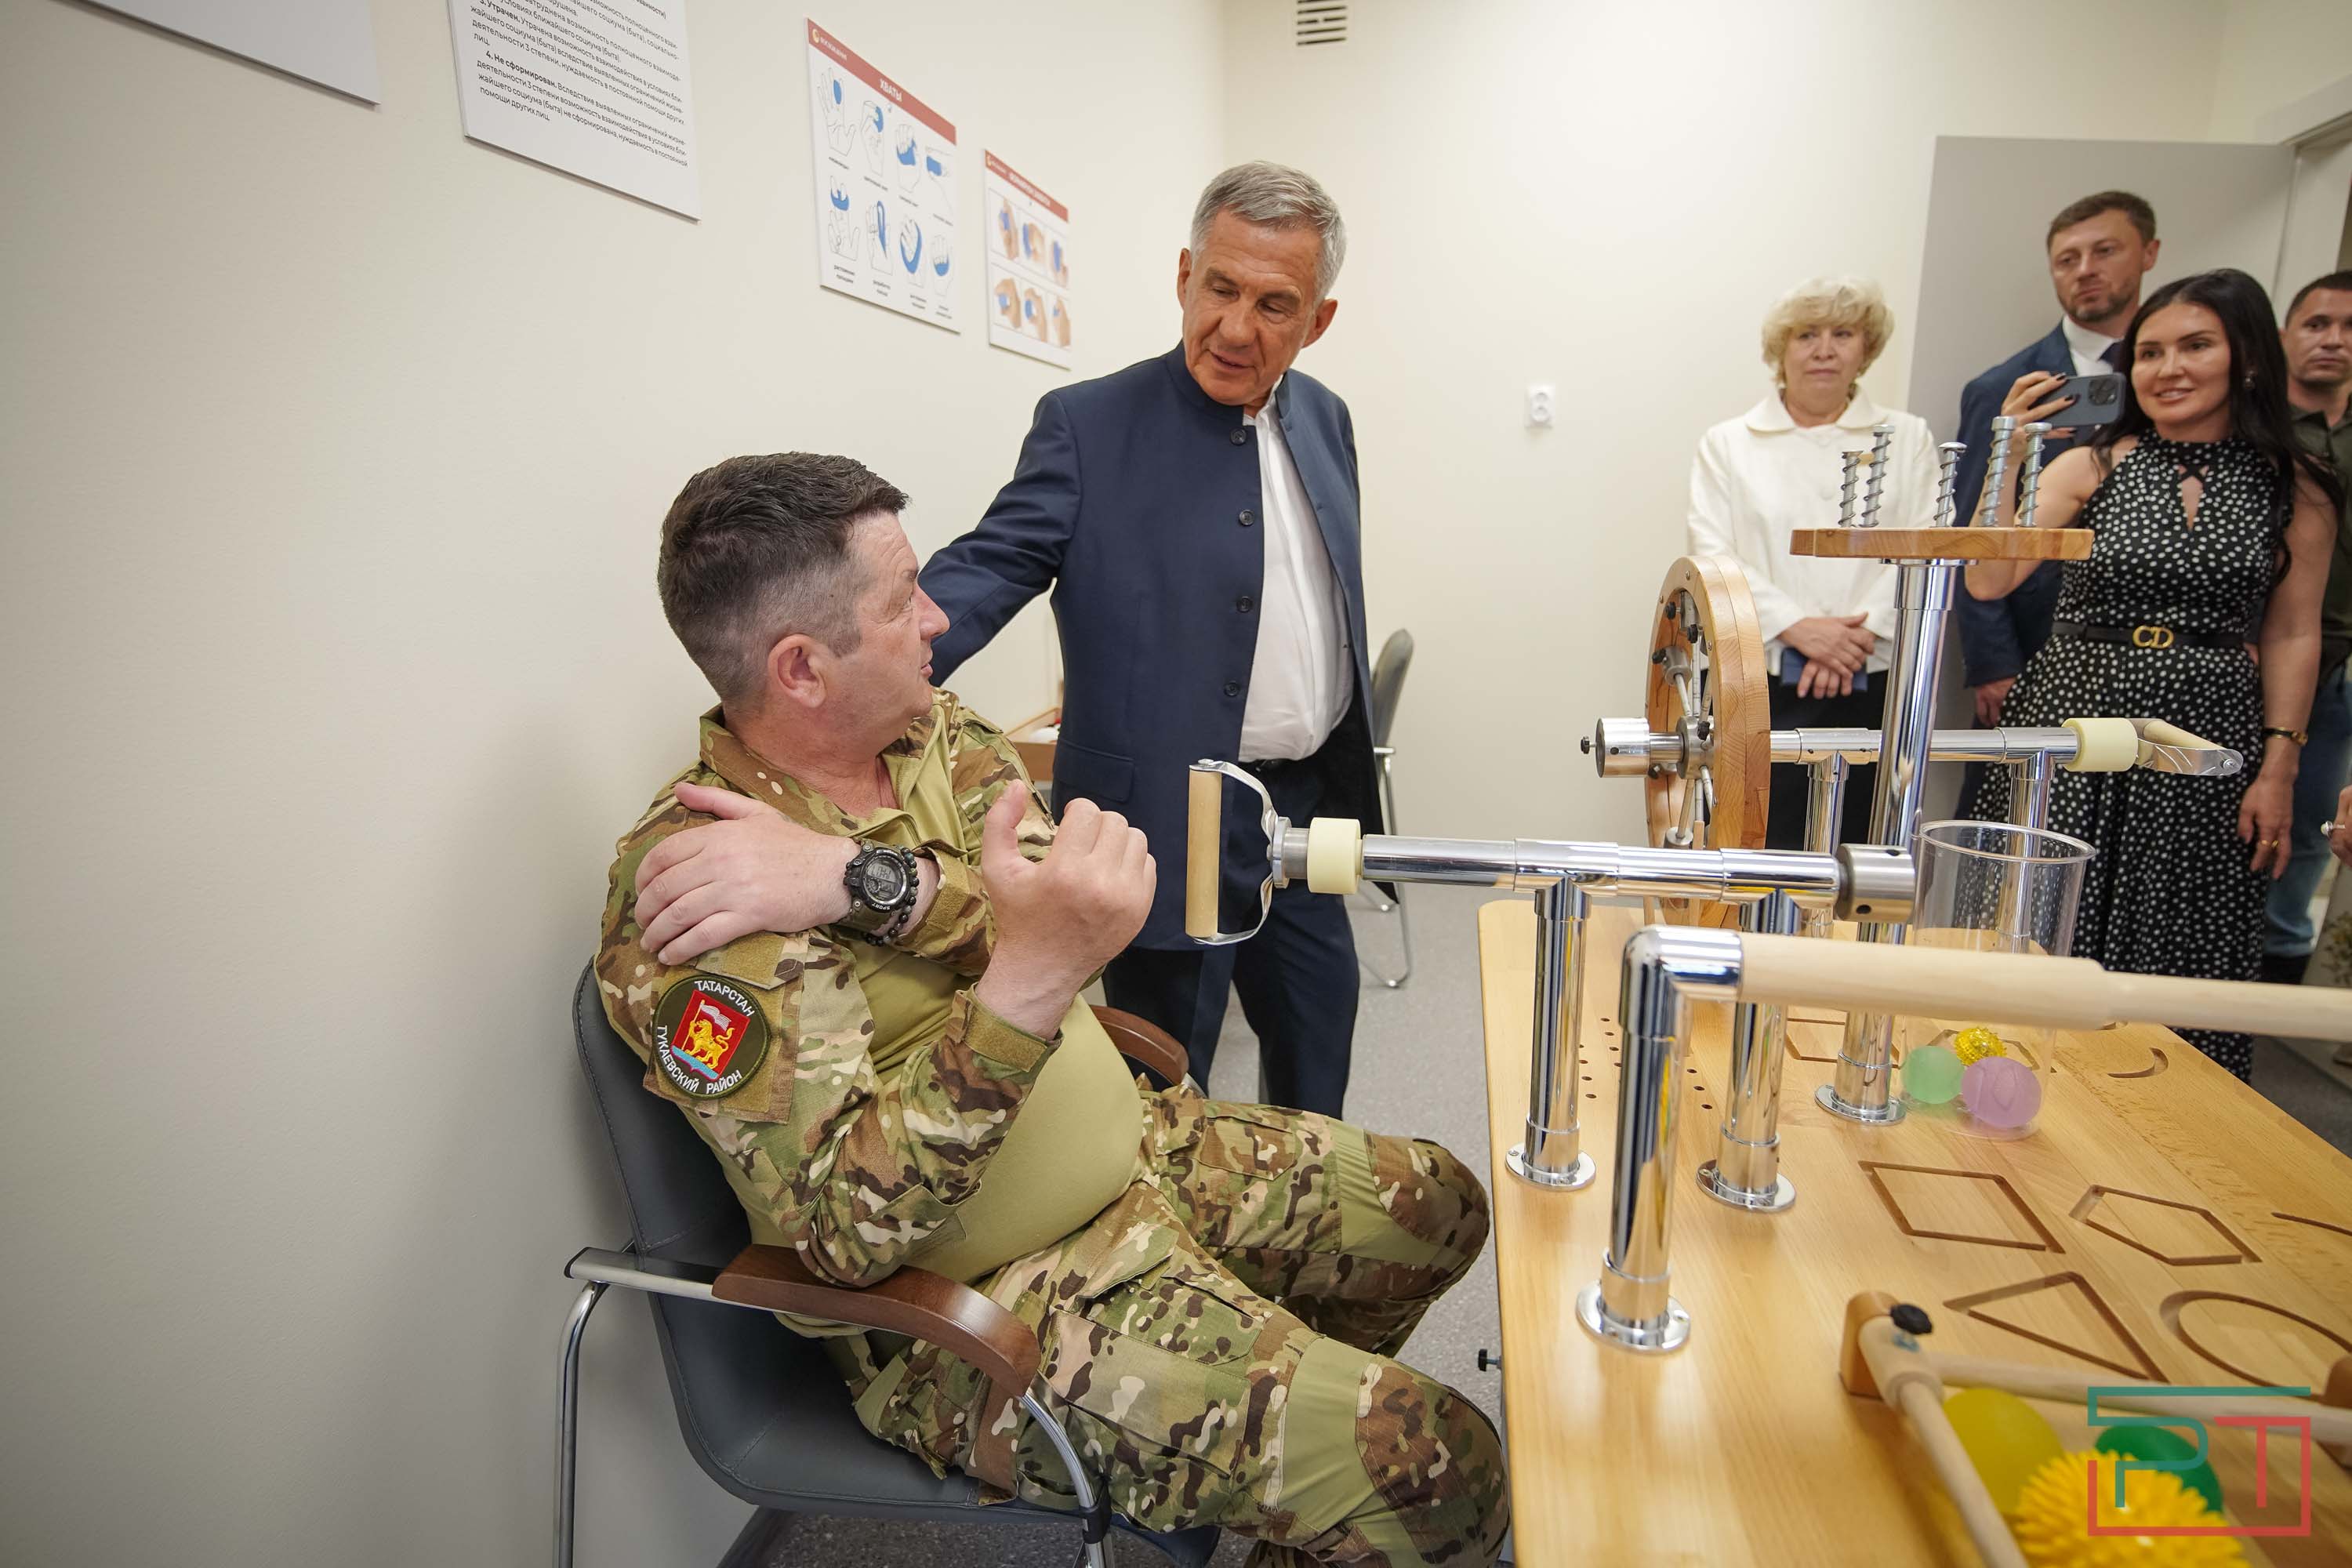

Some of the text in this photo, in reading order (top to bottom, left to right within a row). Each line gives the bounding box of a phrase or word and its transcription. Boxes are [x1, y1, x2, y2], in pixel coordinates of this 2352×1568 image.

[485, 49, 492, 59] 4.
[2132, 625, 2174, 649] CD
[694, 980, 755, 1017] ТАТАРСТАН
[657, 1025, 742, 1094] ТУКАЕВСКИЙ РАЙОН
